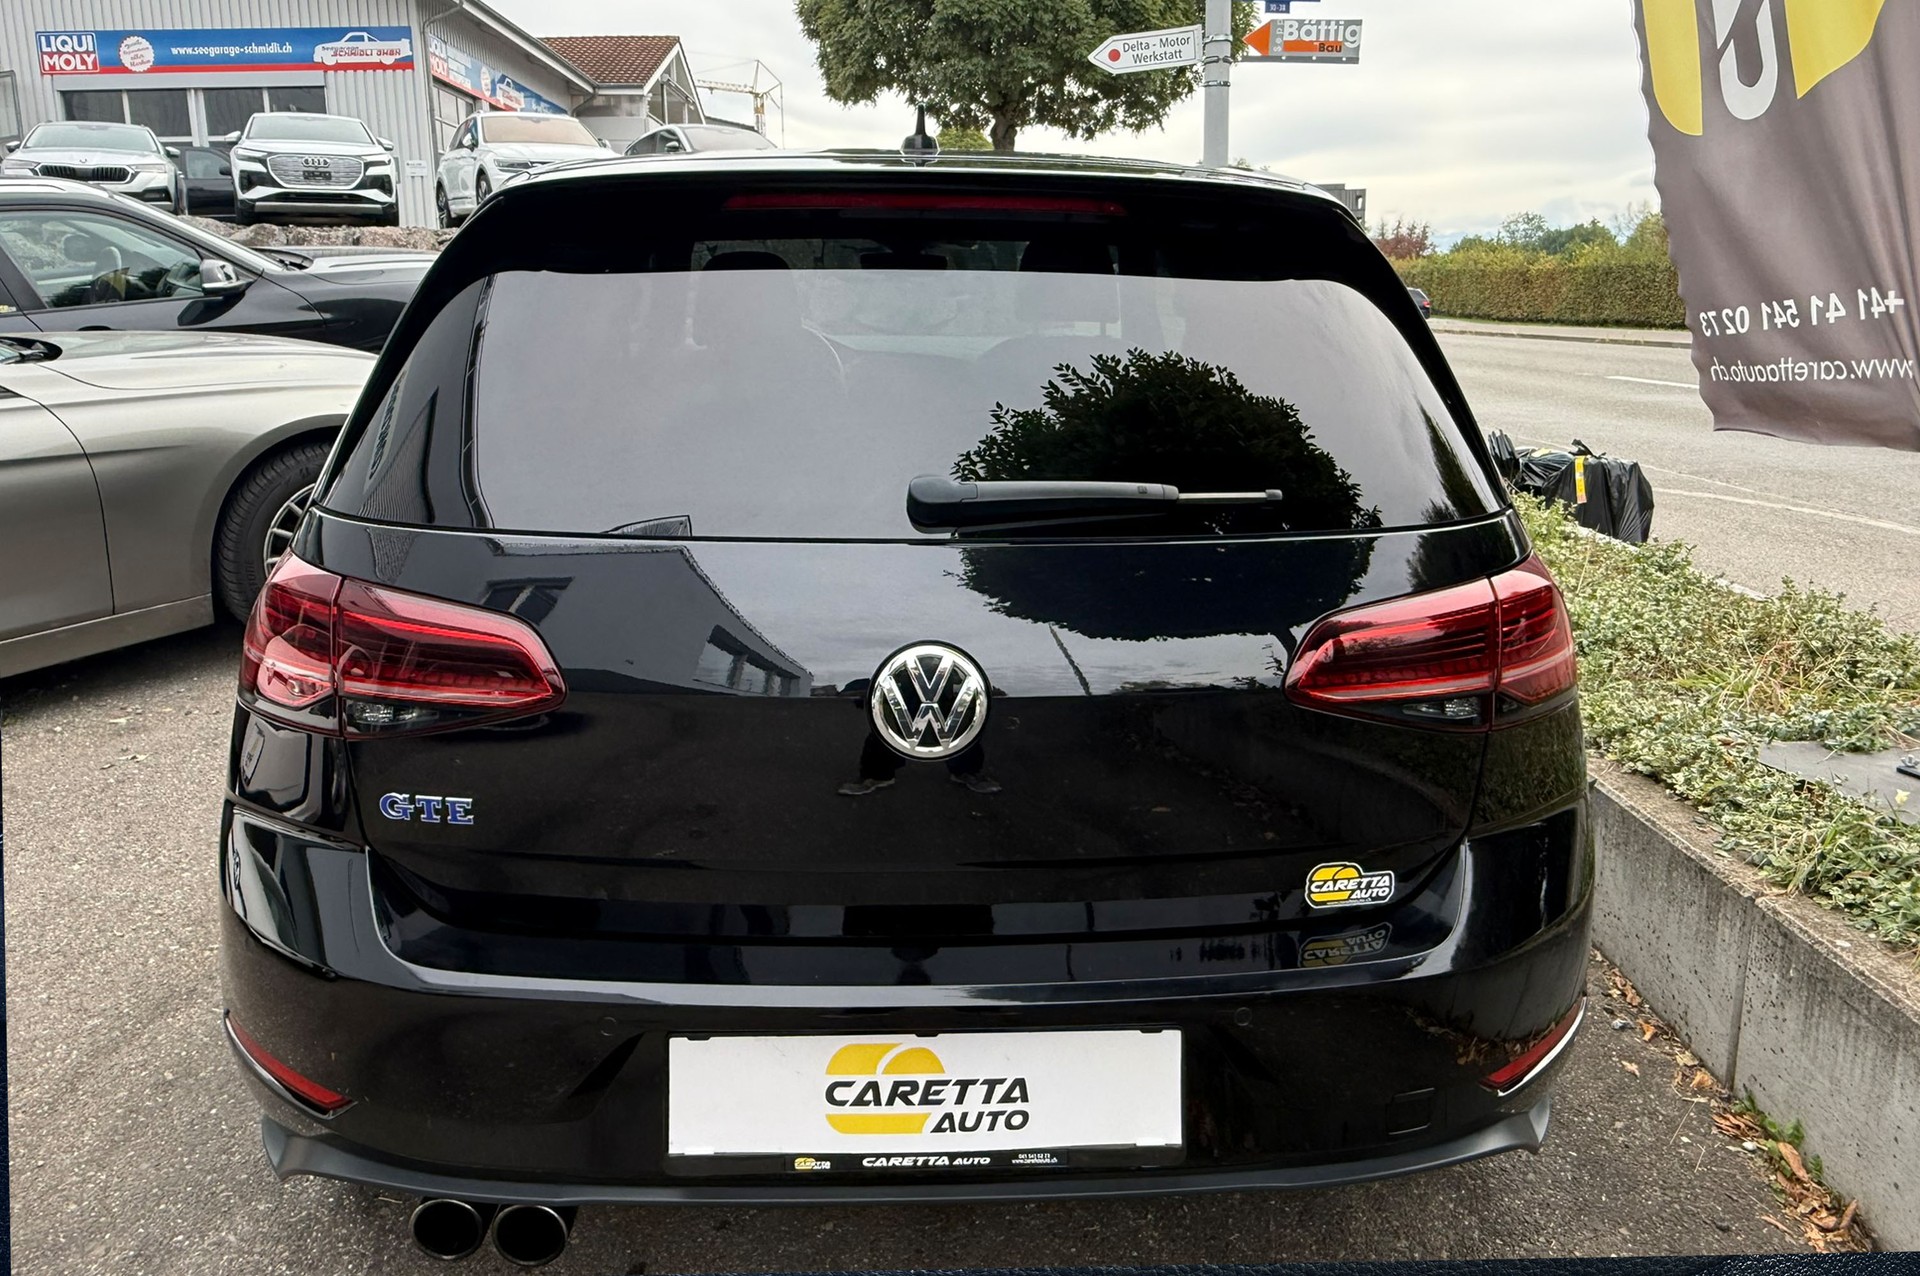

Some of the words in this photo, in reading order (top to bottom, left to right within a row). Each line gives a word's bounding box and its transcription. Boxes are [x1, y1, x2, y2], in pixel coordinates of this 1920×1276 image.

[1283, 19, 1361, 48] Bättig
[40, 34, 94, 53] LIQUI
[170, 42, 293, 57] www.seegarage-schmidli.ch
[1122, 40, 1150, 53] Delta
[1159, 36, 1190, 48] Motor
[1318, 42, 1342, 52] Bau
[43, 53, 97, 72] MOLY
[1132, 49, 1183, 64] Werkstatt
[379, 792, 474, 825] GTE
[1310, 875, 1390, 893] CARETTA
[1350, 888, 1390, 899] AUTO
[825, 1078, 1030, 1107] CARETTA
[930, 1110, 1030, 1134] AUTO
[862, 1156, 950, 1167] CARETTA
[952, 1157, 991, 1166] AUTO
